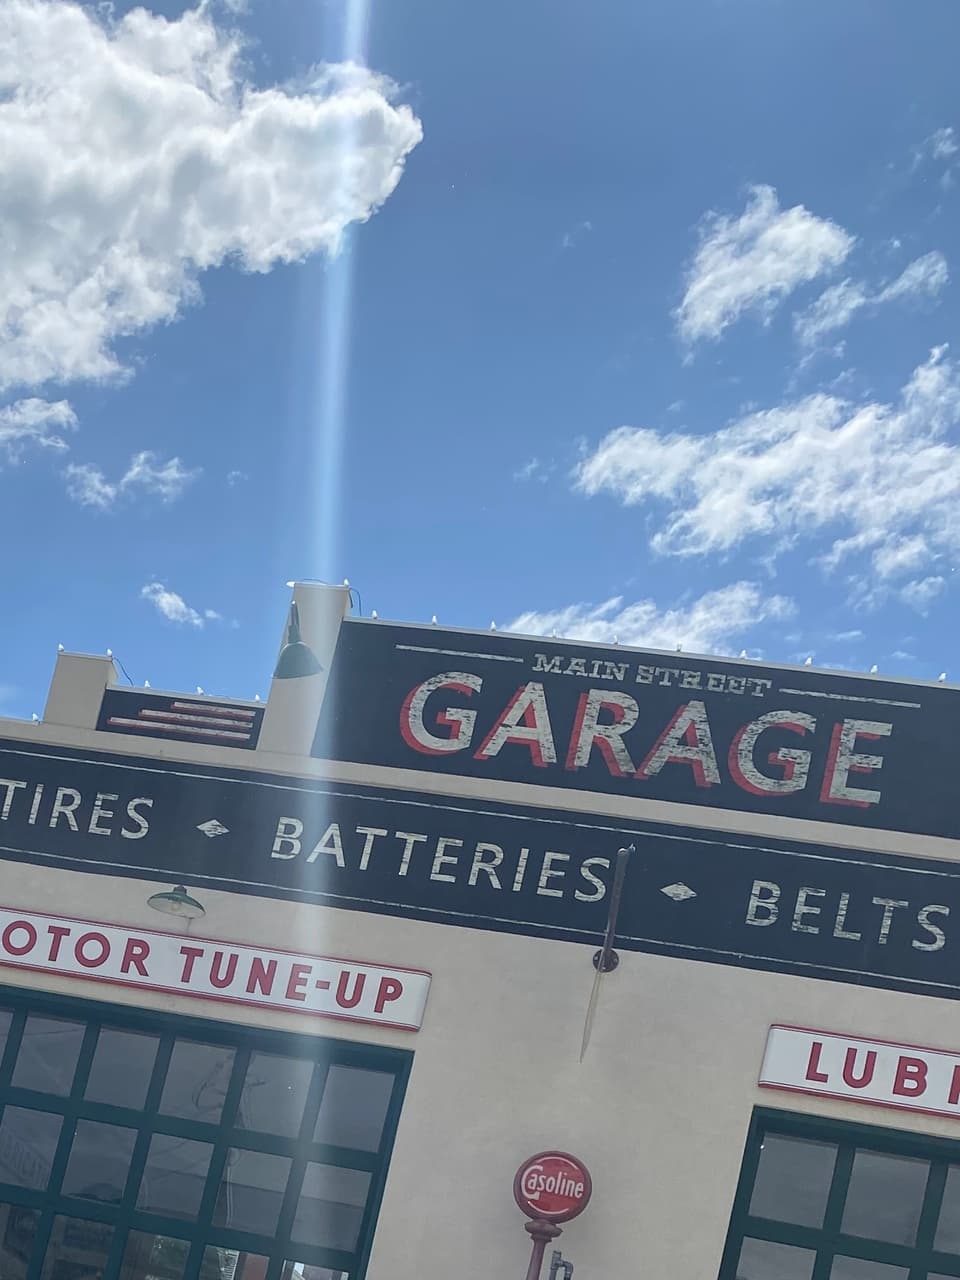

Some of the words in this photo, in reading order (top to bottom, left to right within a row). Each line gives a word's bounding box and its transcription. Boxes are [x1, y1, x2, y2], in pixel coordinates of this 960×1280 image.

[532, 653, 629, 681] MAIN
[635, 664, 773, 698] STREET
[400, 671, 893, 808] GARAGE
[271, 816, 610, 903] BATTERIES
[745, 879, 951, 951] BELTS
[179, 946, 403, 1014] TUNE-UP
[806, 1041, 960, 1105] LUB
[521, 1164, 584, 1200] Gasoline
